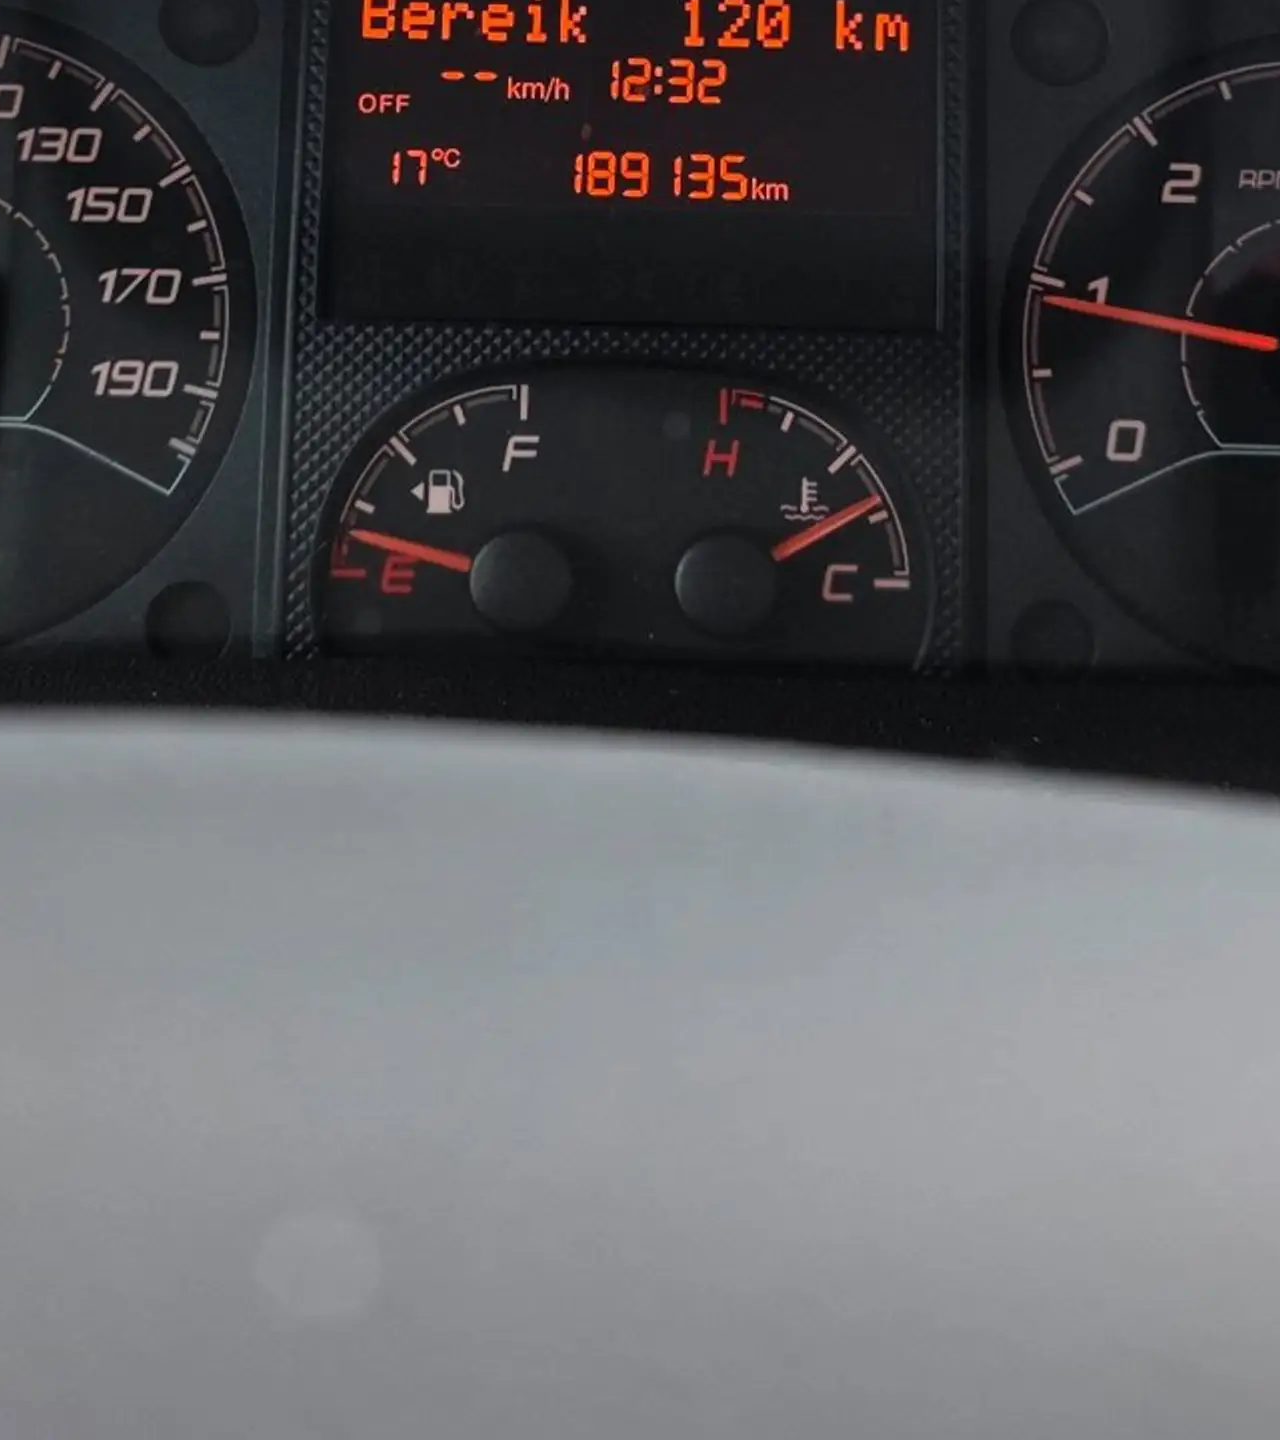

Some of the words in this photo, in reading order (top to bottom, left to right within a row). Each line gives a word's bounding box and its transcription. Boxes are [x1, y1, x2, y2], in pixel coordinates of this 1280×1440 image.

[836, 0, 909, 51] km
[508, 77, 569, 101] km/h
[611, 58, 727, 104] 12:32
[359, 94, 409, 113] OFF
[17, 127, 102, 162] 130
[1162, 163, 1201, 203] 2
[68, 187, 152, 222] 150
[99, 268, 181, 304] 170
[92, 360, 178, 397] 190
[503, 436, 539, 471] F
[704, 440, 739, 476] H
[1107, 420, 1146, 461] 0
[380, 557, 416, 595] E
[823, 564, 858, 601] C
